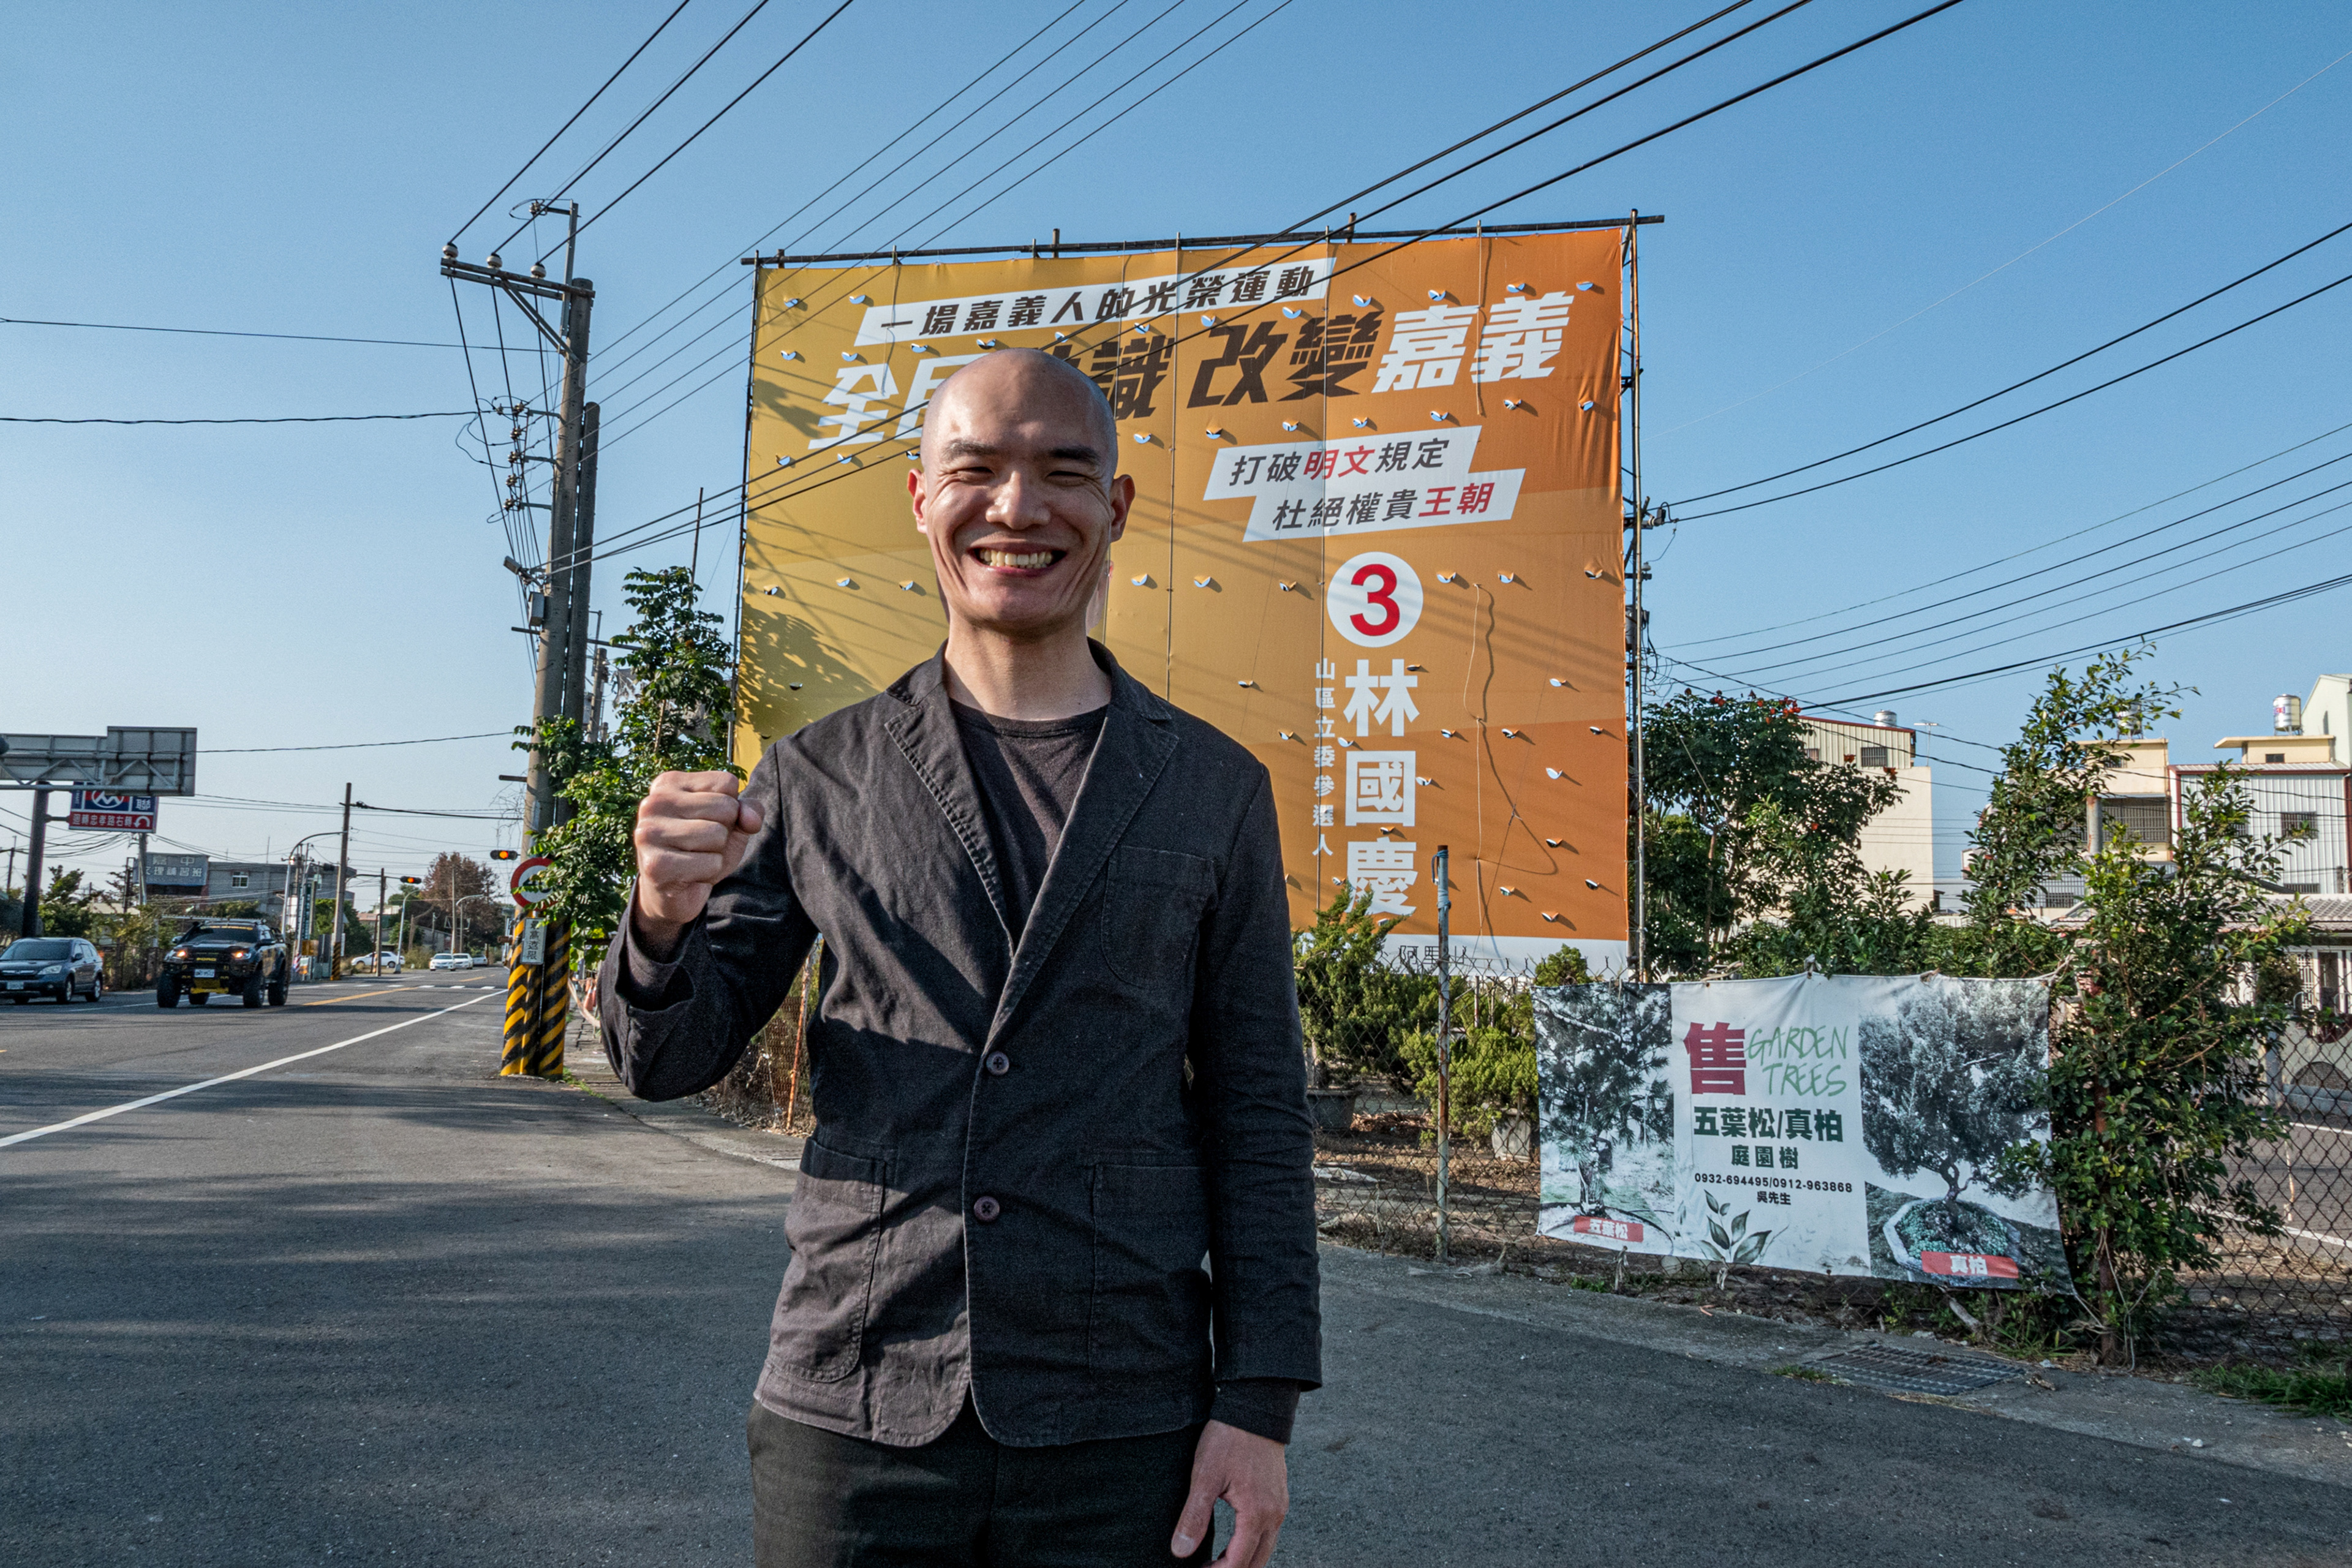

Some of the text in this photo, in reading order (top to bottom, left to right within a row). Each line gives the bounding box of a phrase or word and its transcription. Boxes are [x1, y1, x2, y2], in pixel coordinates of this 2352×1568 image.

[881, 266, 1315, 336] 一場嘉義人的光榮運動
[808, 335, 1175, 450] 全識
[1229, 437, 1450, 486] 打破明文規定
[1272, 482, 1495, 531] 杜絕權貴王朝
[1349, 564, 1401, 636] 3
[1312, 658, 1336, 856] 山區立委參選人
[1343, 658, 1420, 916] 林國慶
[1683, 1021, 1746, 1095] 售
[1746, 1025, 1849, 1066] GARDEN
[1762, 1063, 1847, 1096] TREES
[1694, 1106, 1843, 1142] 五葉松/真柏
[1731, 1145, 1798, 1169] 庭園樹
[1694, 1172, 1852, 1193] 0932-694495/0912-963868
[1757, 1191, 1792, 1205] 吳先生
[1588, 1218, 1628, 1240] 五葉松
[1950, 1255, 1988, 1275] 真柏
